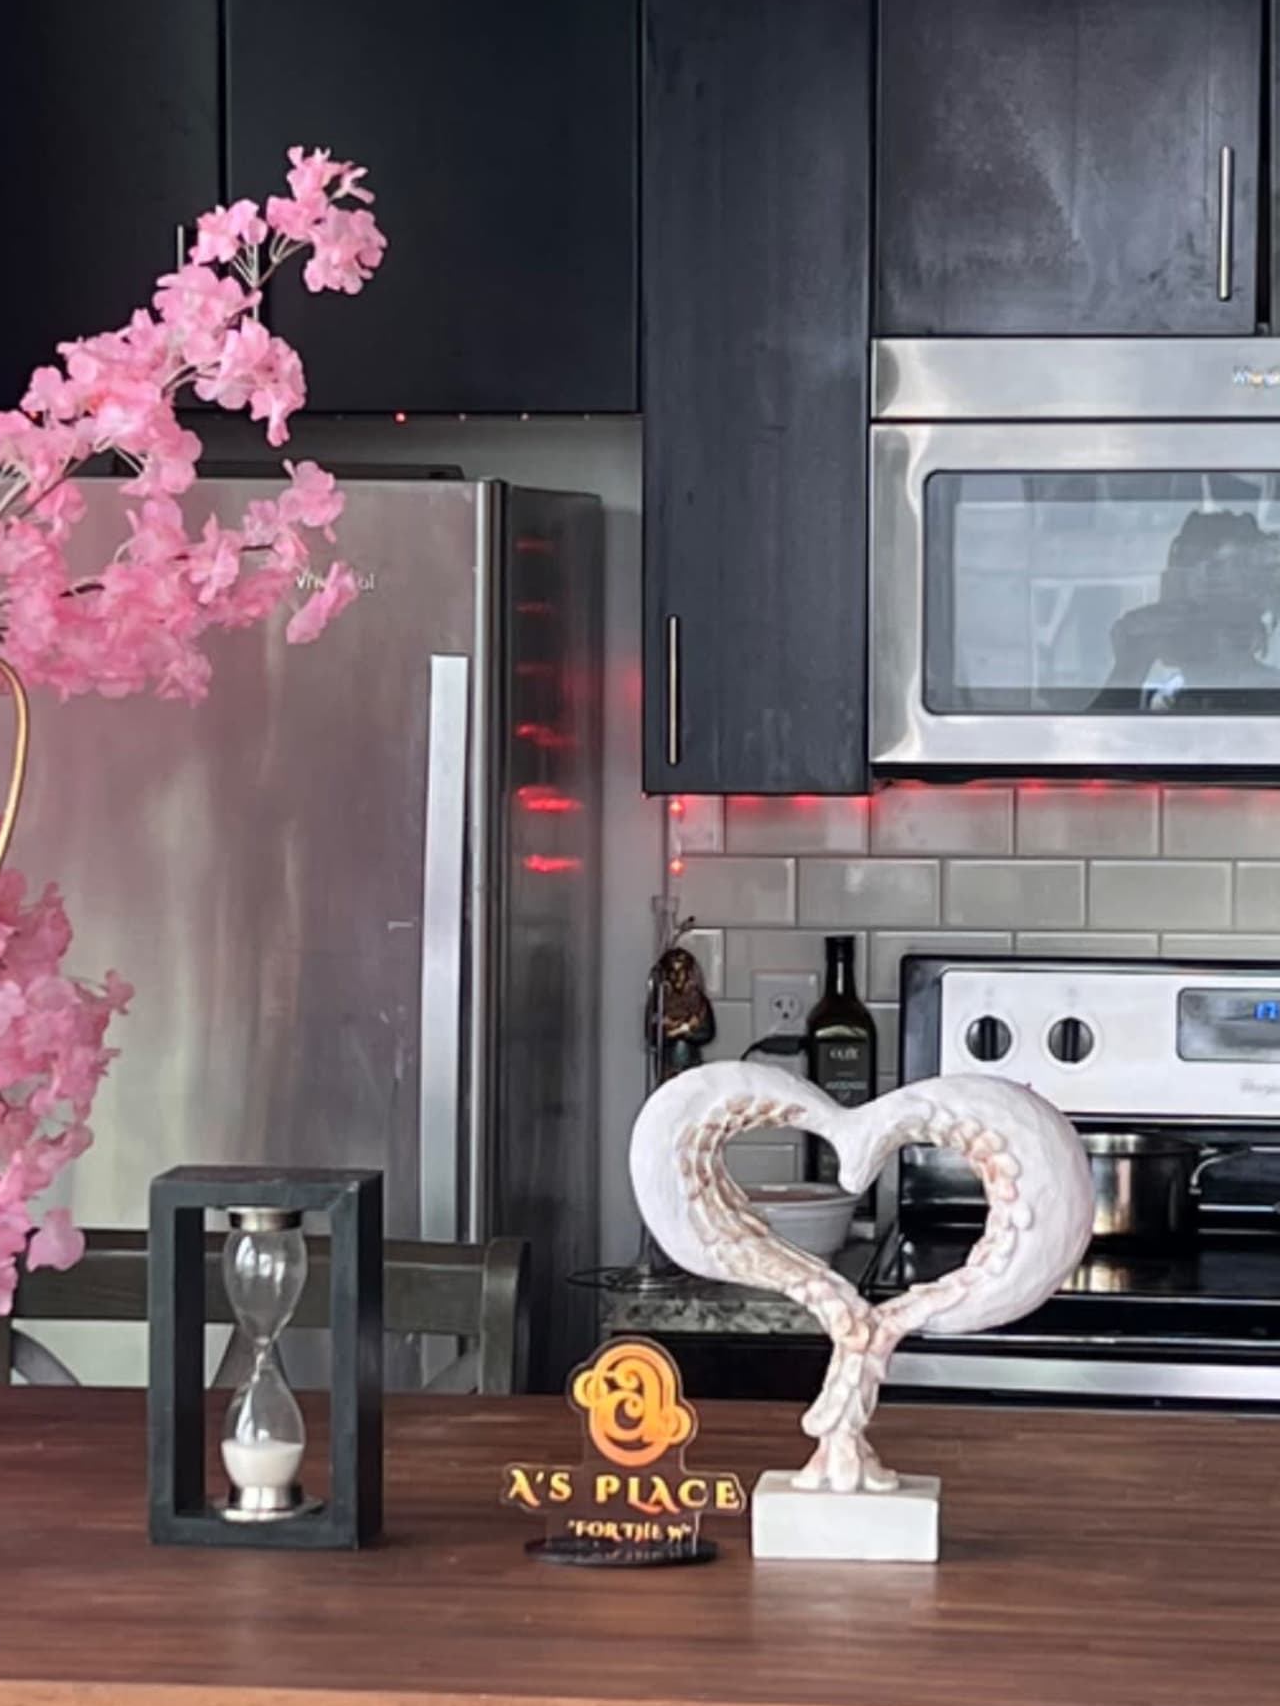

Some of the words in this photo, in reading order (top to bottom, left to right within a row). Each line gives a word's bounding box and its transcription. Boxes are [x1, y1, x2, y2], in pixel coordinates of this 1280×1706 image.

[508, 1469, 573, 1507] A'S
[595, 1474, 741, 1515] PLACE
[621, 1521, 663, 1542] THE
